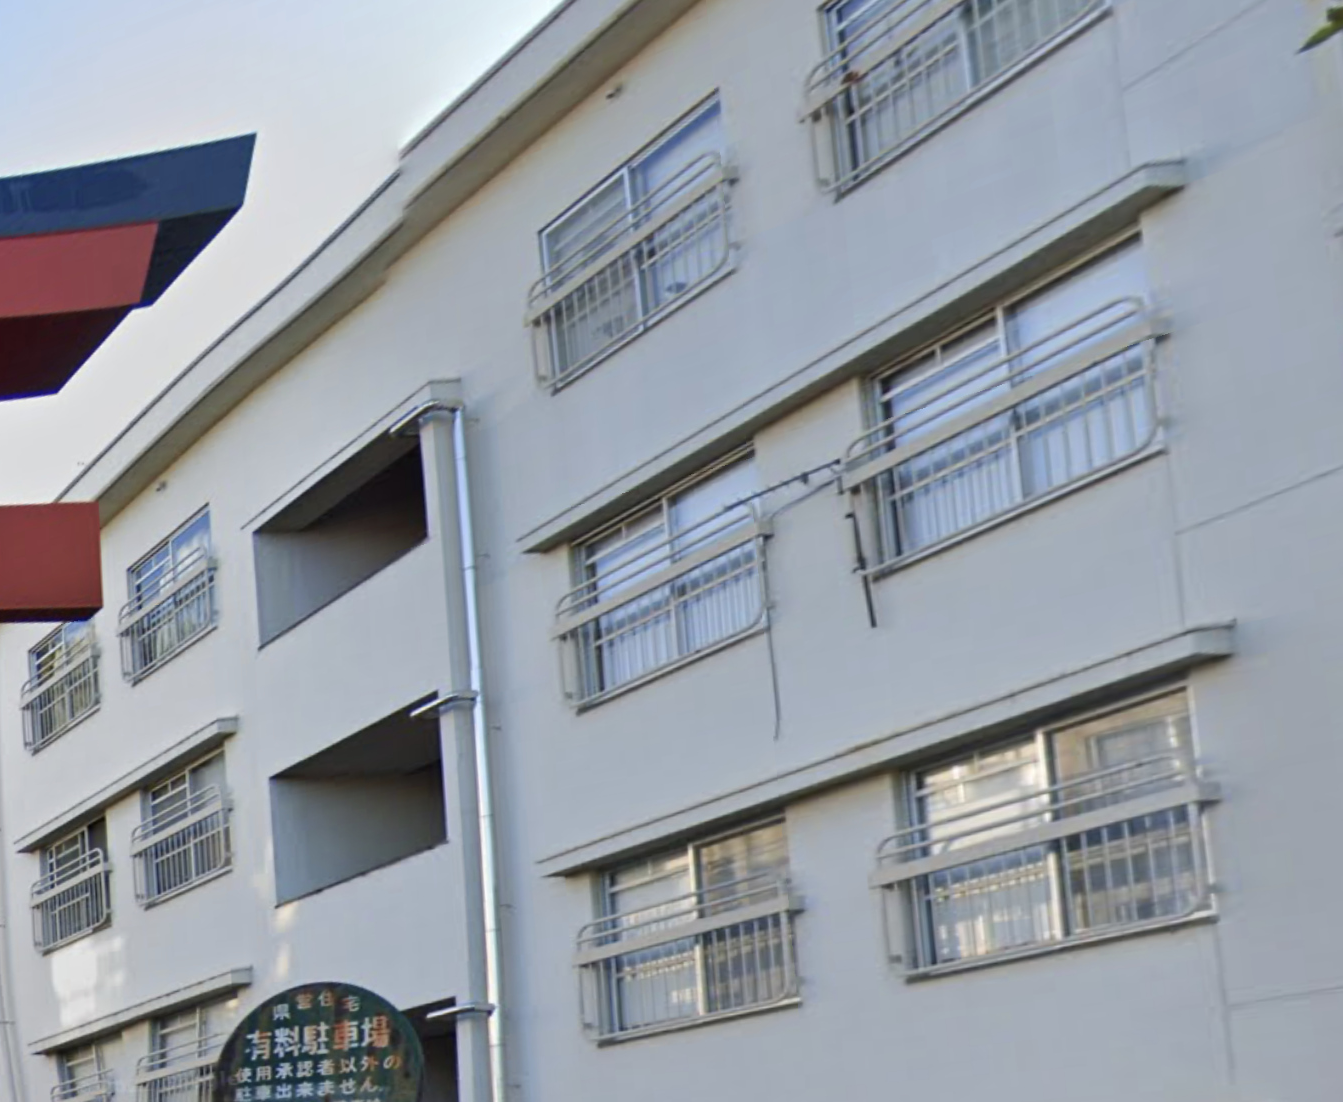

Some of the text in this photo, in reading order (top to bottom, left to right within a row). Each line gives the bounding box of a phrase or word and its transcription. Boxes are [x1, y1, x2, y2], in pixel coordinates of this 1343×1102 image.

[245, 1014, 390, 1061] 有料駐車場
[234, 1055, 401, 1084] 使用承認者以外の
